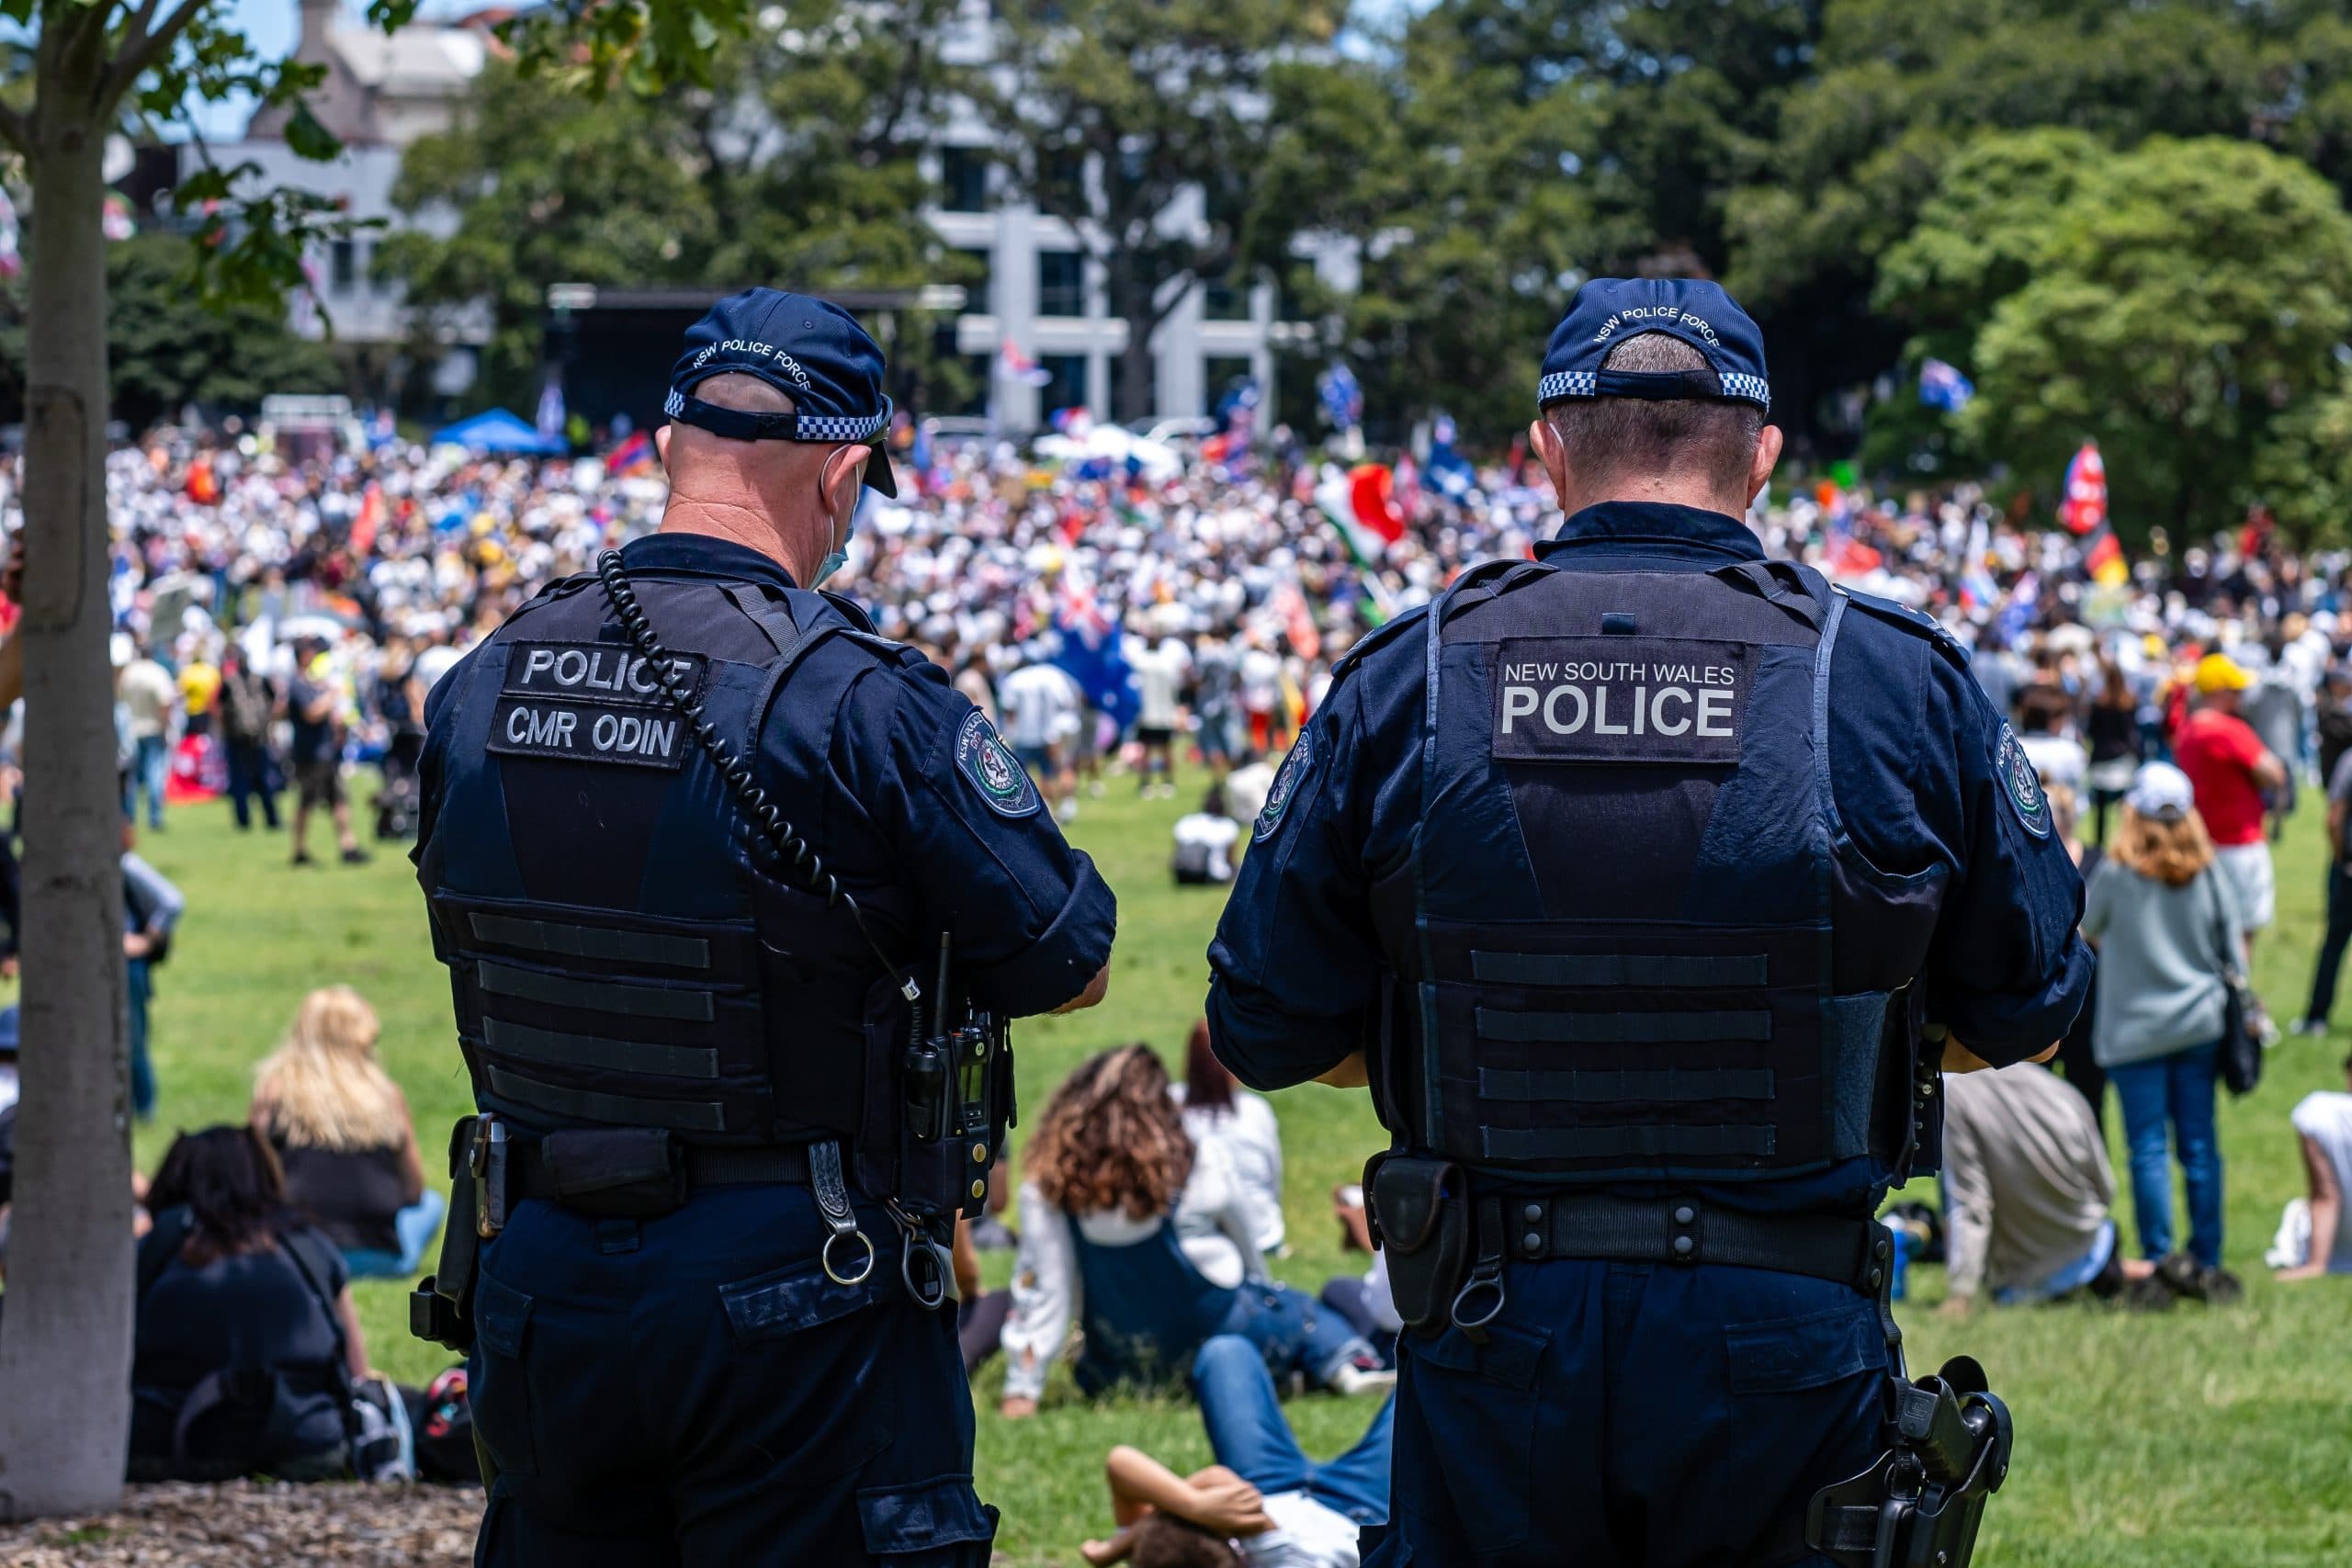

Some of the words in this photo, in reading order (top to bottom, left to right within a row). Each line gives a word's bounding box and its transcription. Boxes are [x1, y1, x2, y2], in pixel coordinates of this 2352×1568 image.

[1594, 314, 1620, 344] NSW
[1623, 307, 1679, 320] POLICE
[1679, 313, 1721, 347] FORCE
[693, 342, 718, 369] NSW
[721, 339, 774, 356] POLICE
[774, 351, 811, 390] FORCE
[1505, 663, 1558, 682] NEW
[1564, 661, 1645, 682] SOUTH
[1653, 663, 1735, 685] WALES
[506, 706, 577, 748] CMR
[593, 714, 676, 757] ODIN
[1501, 684, 1735, 737] POLICE
